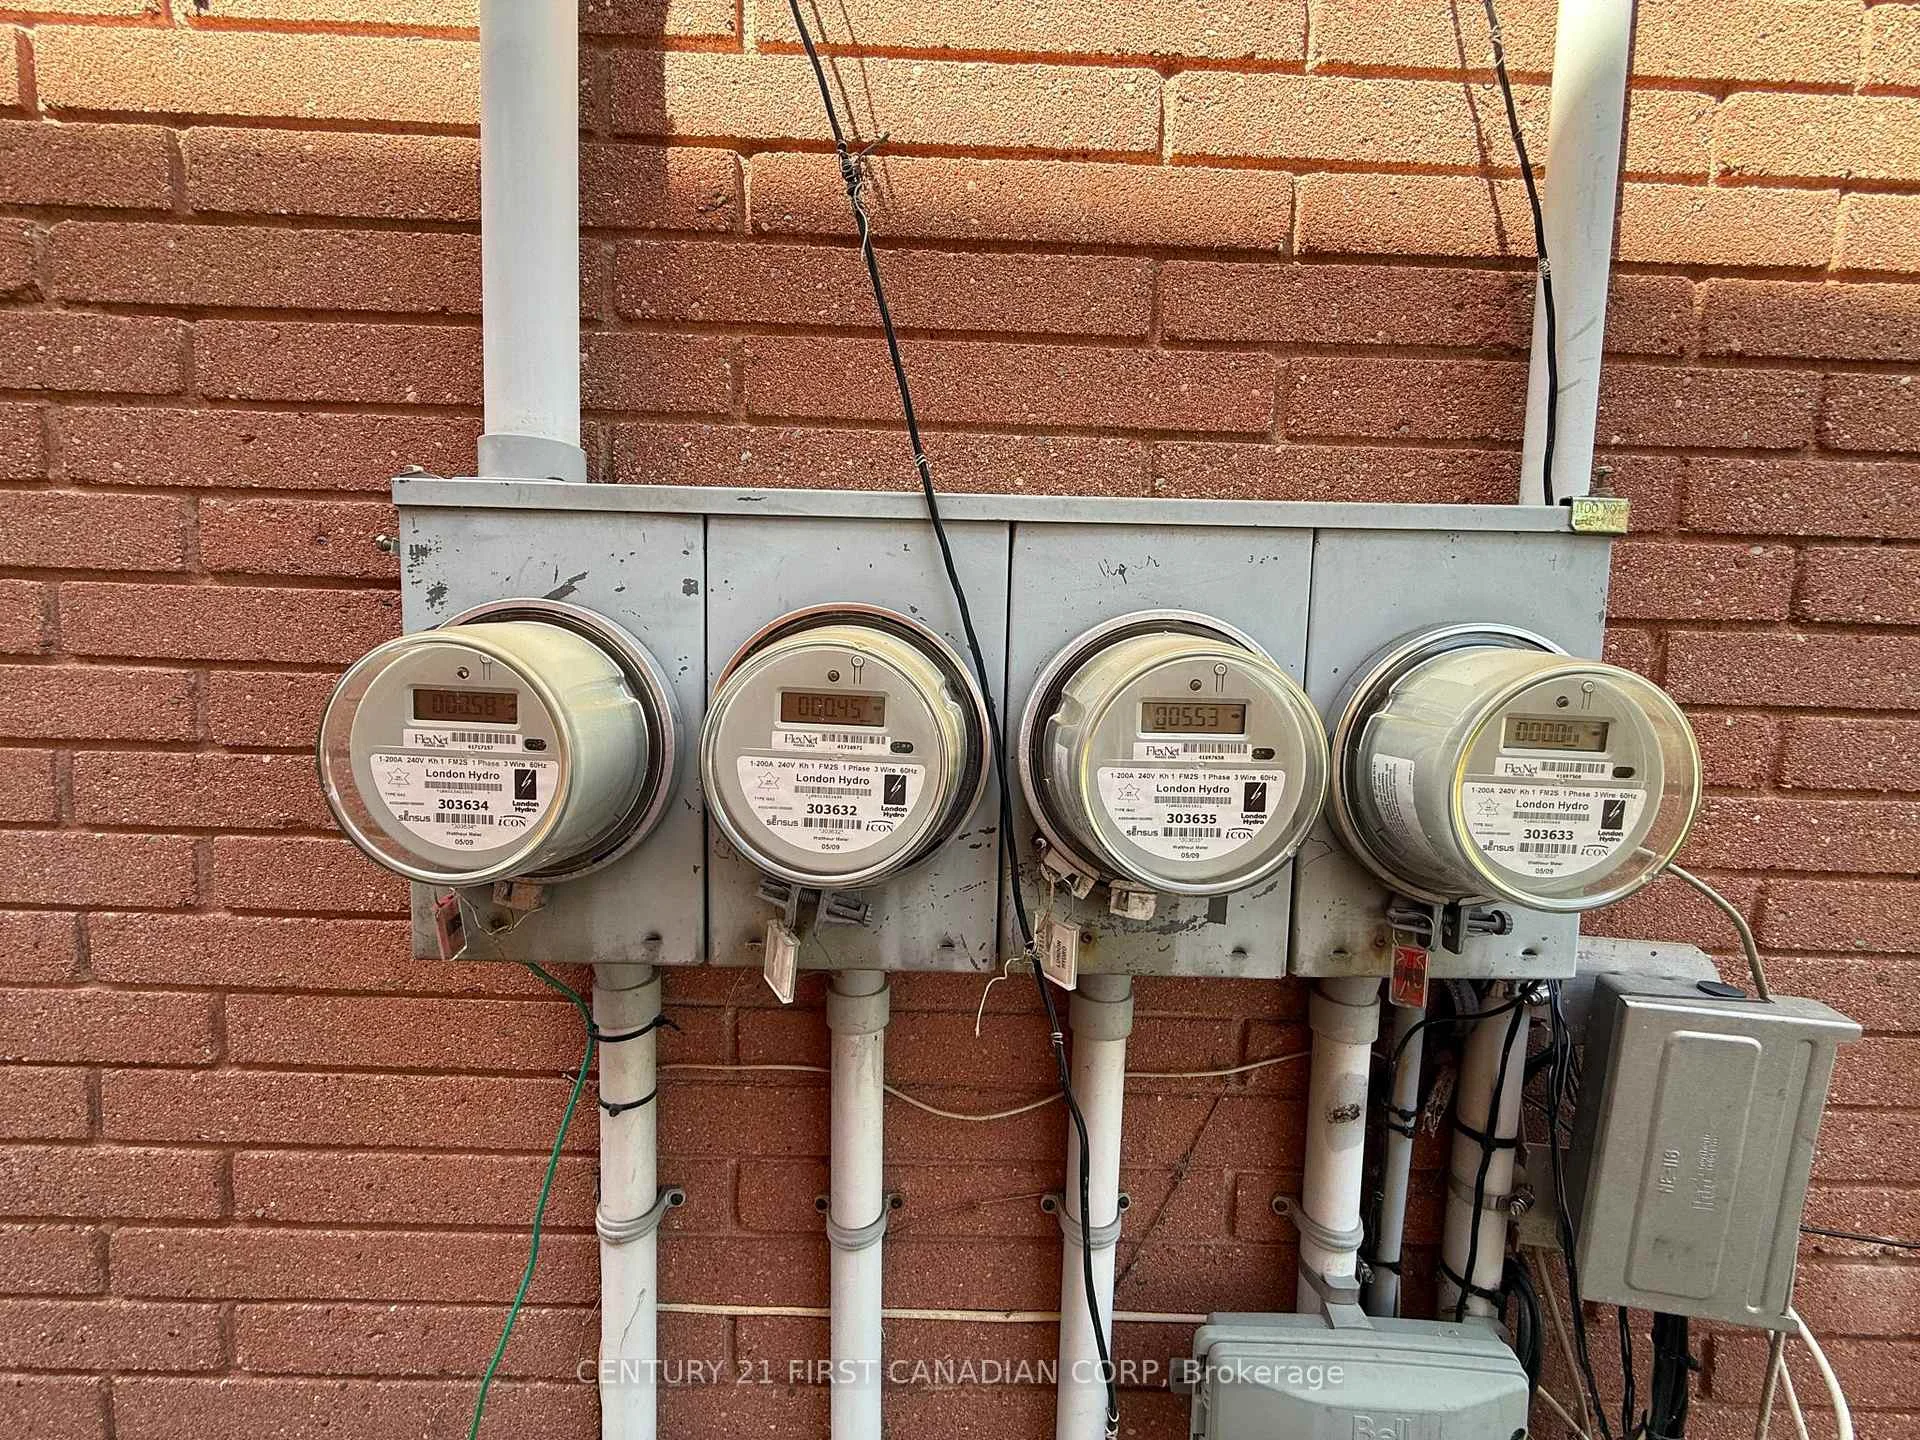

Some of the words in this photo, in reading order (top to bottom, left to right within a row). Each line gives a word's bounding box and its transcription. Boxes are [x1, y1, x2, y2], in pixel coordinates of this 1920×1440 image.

[415, 734, 448, 745] FlexNet
[784, 734, 818, 744] FlexNet
[1146, 746, 1179, 756] FlexNet
[1504, 763, 1537, 774] FlexNet
[426, 769, 465, 778] London
[468, 771, 500, 782] Hydro
[796, 774, 835, 784] London
[839, 776, 869, 786] Hydro
[1156, 784, 1195, 793] London
[1199, 785, 1229, 794] Hydro
[438, 800, 488, 811] 303634
[807, 804, 857, 816] 303632
[1516, 800, 1555, 809] London
[1558, 801, 1589, 811] Hydro
[1167, 814, 1216, 824] 303635
[1524, 829, 1574, 840] 303633
